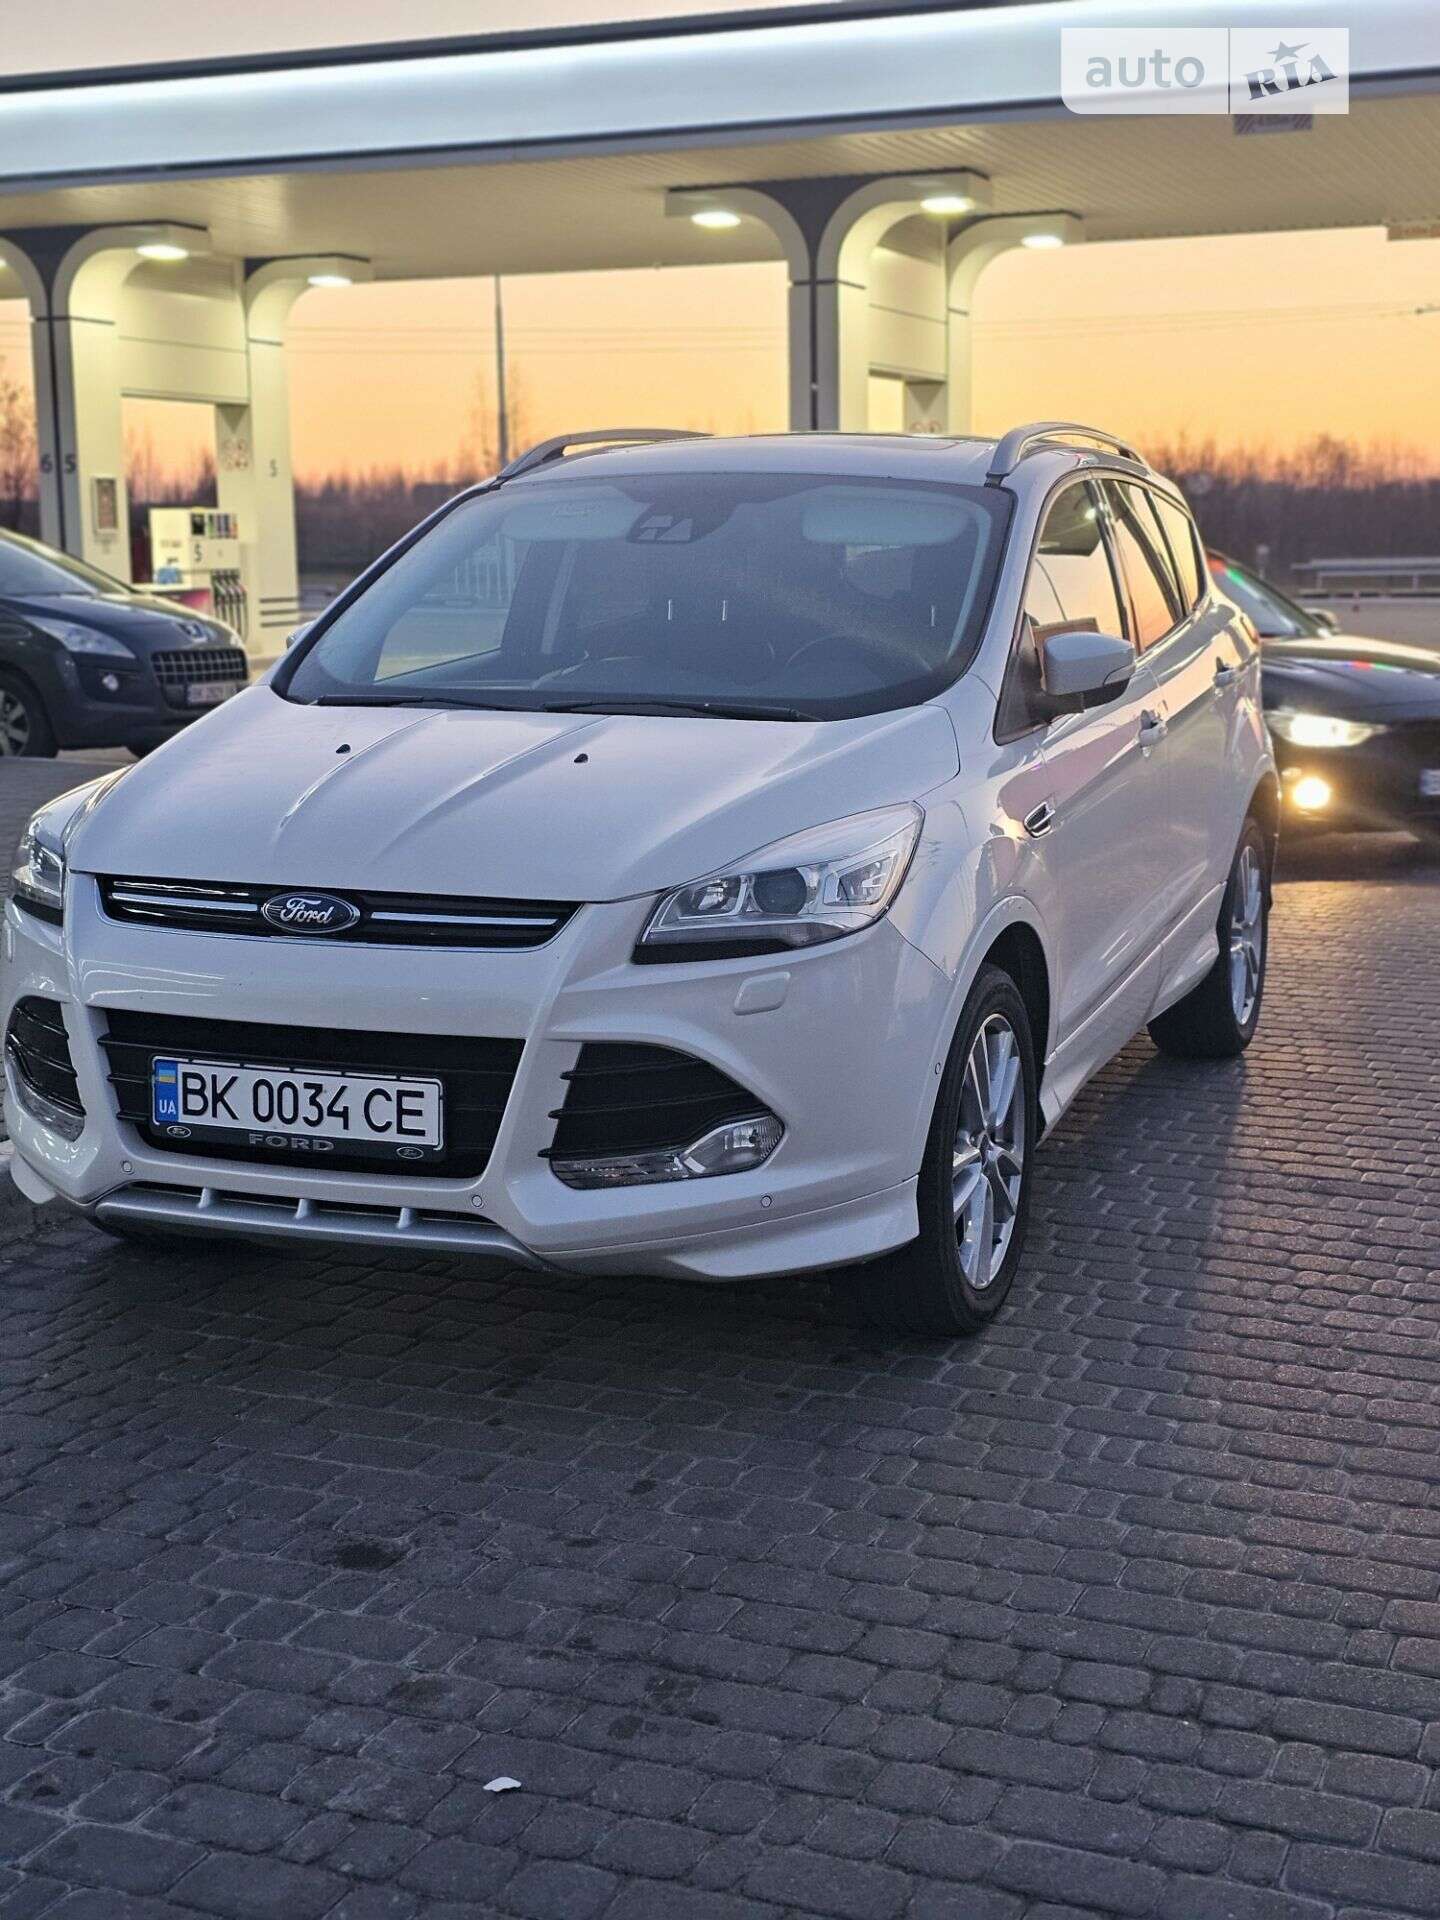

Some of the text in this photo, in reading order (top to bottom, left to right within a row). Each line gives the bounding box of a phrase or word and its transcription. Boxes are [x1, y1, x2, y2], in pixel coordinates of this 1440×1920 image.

[40, 453, 53, 474] 6
[64, 453, 77, 474] 5
[279, 897, 335, 925] Ford
[159, 1098, 177, 1116] UA
[181, 1071, 427, 1137] BK 0034 CE
[248, 1132, 336, 1152] FORD
